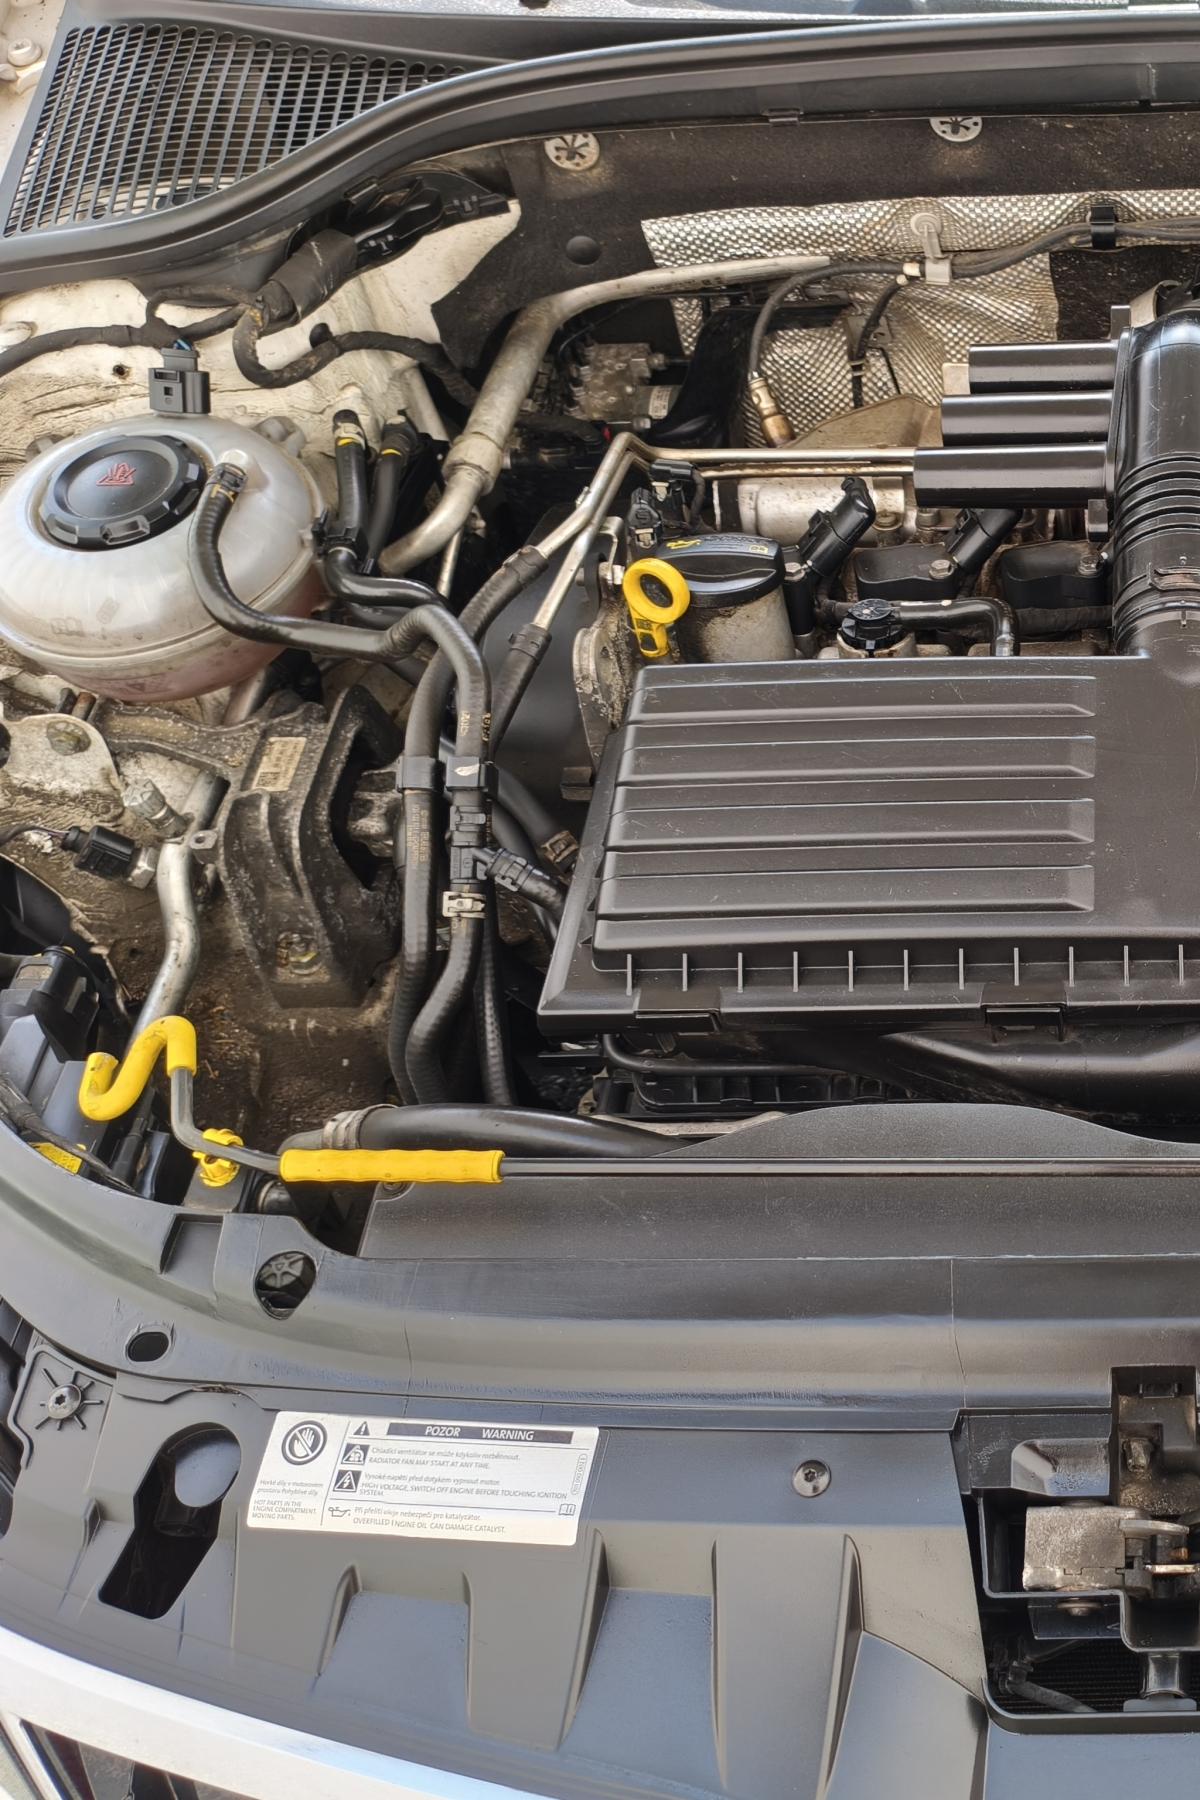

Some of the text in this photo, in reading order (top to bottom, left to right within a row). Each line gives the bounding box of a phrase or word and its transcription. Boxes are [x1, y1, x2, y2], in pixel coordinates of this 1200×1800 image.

[425, 1426, 535, 1440] POZOR WARNING
[537, 1491, 567, 1499] IGNITION
[353, 1518, 390, 1526] OVERFILLED
